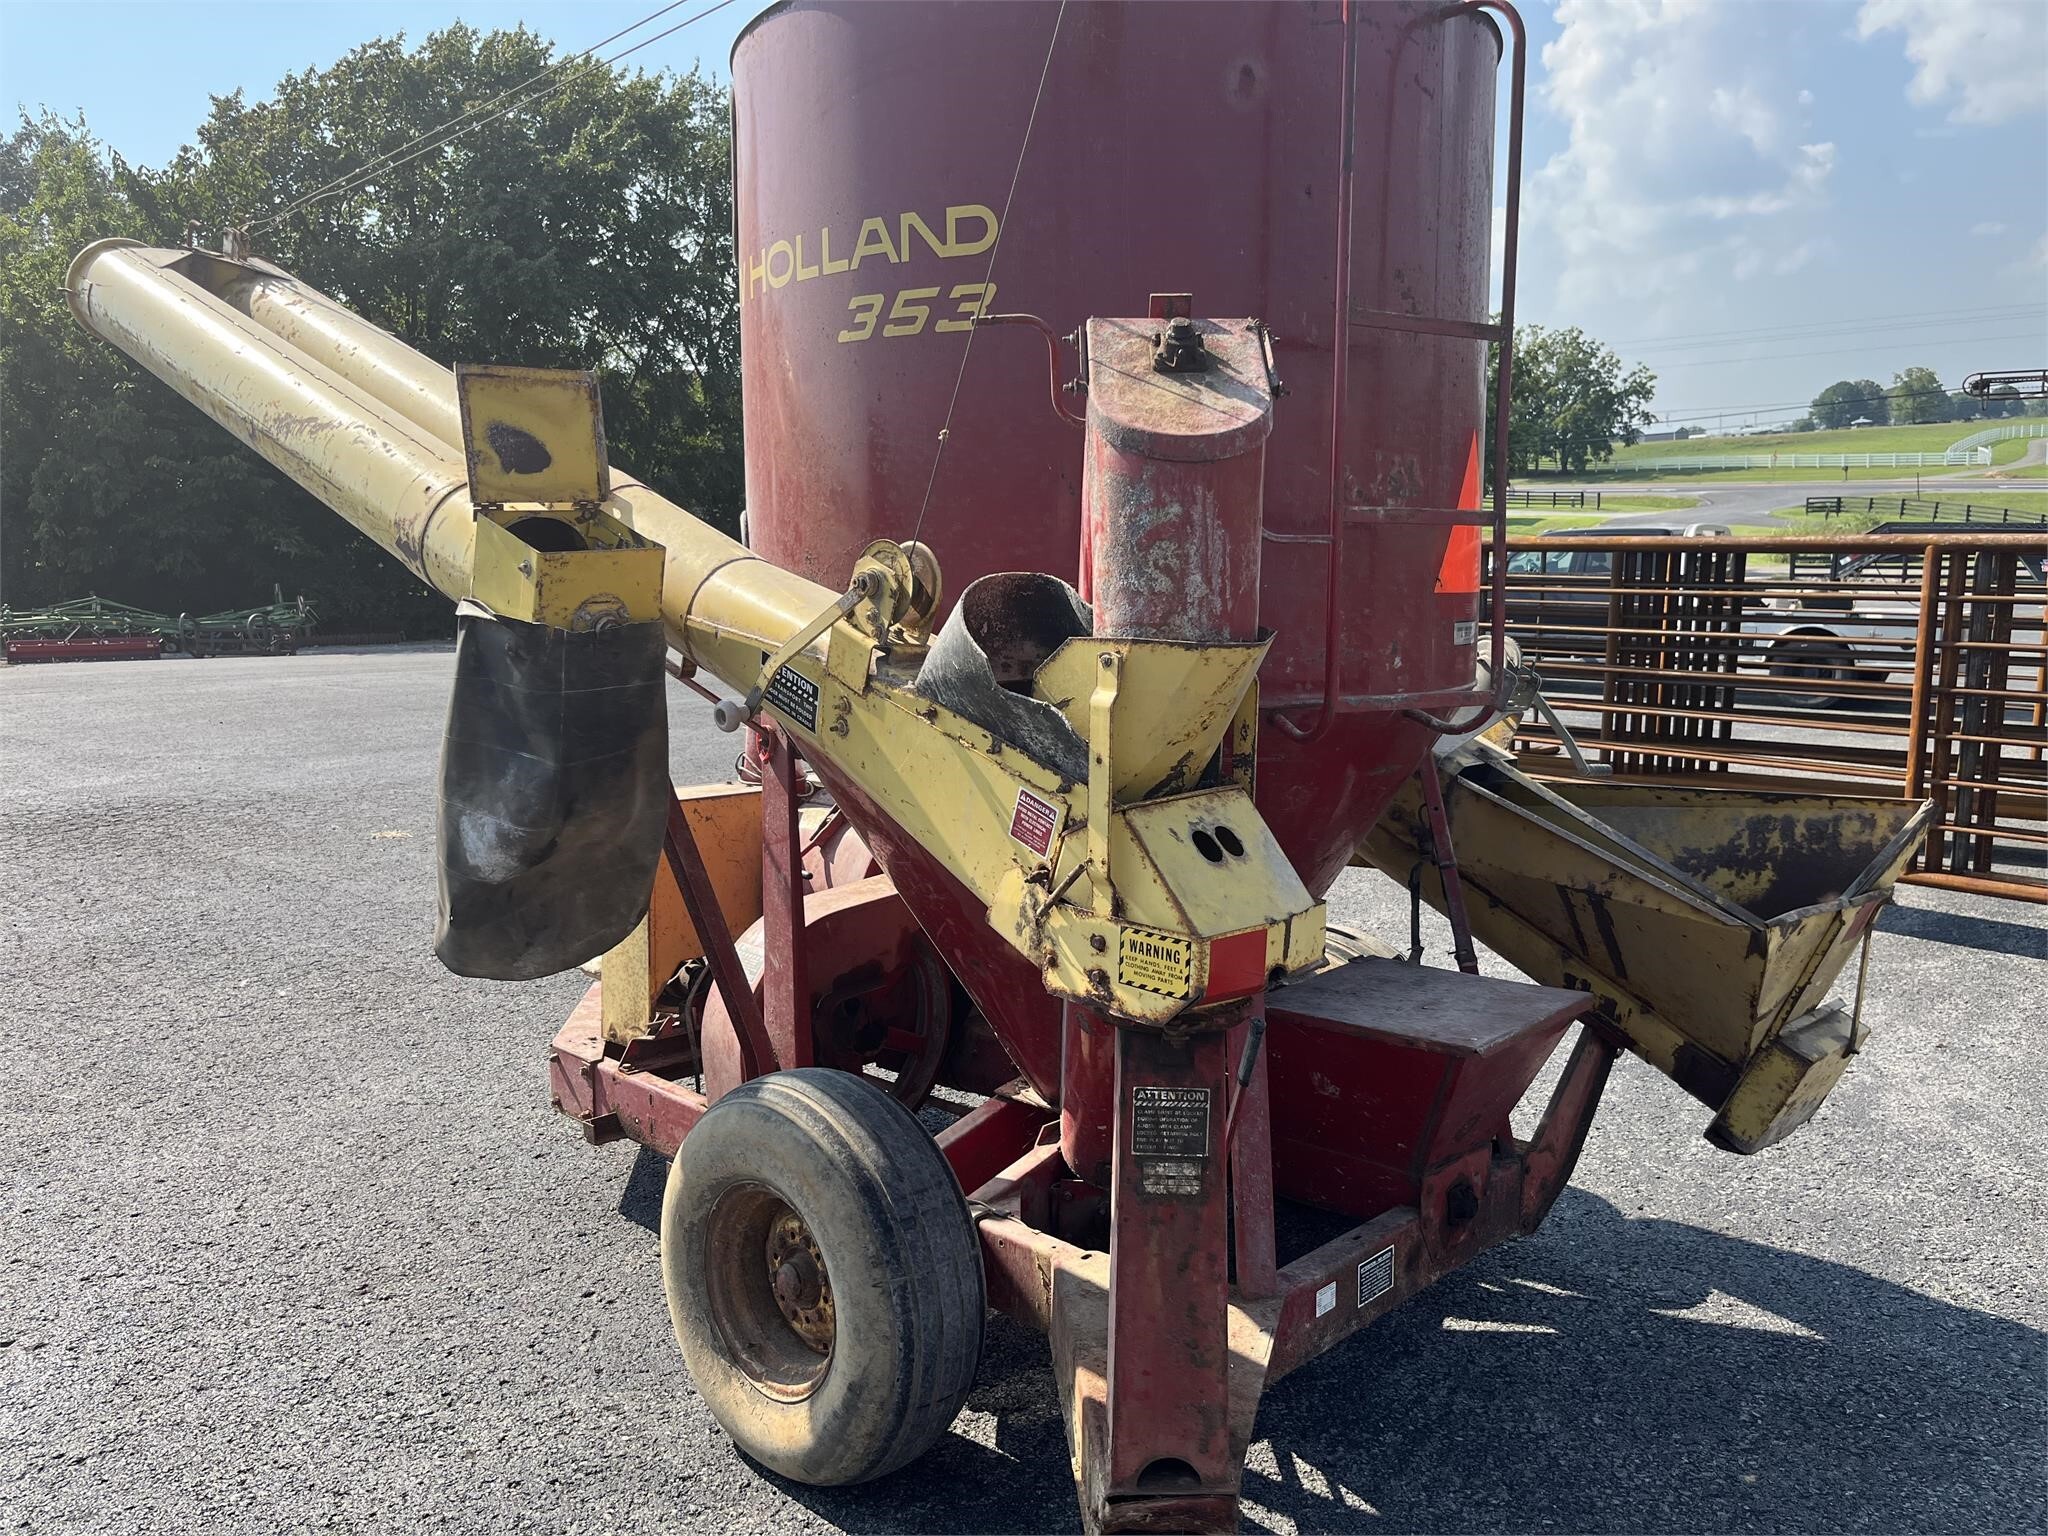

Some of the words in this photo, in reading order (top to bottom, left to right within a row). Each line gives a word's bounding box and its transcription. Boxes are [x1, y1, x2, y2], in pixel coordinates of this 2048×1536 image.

[749, 204, 999, 300] HOLLAND
[837, 282, 998, 344] 353
[778, 667, 813, 695] ENTION
[774, 682, 801, 703] TRANSPORT
[1026, 798, 1050, 816] DANGER
[1129, 938, 1180, 965] WARNING
[1125, 961, 1149, 972] CLOTHING
[1152, 968, 1166, 977] AWAY
[1168, 972, 1183, 980] FROM
[1134, 970, 1155, 981] MOVING
[1157, 976, 1173, 986] PARTS
[1137, 1090, 1205, 1101] ATTENTION
